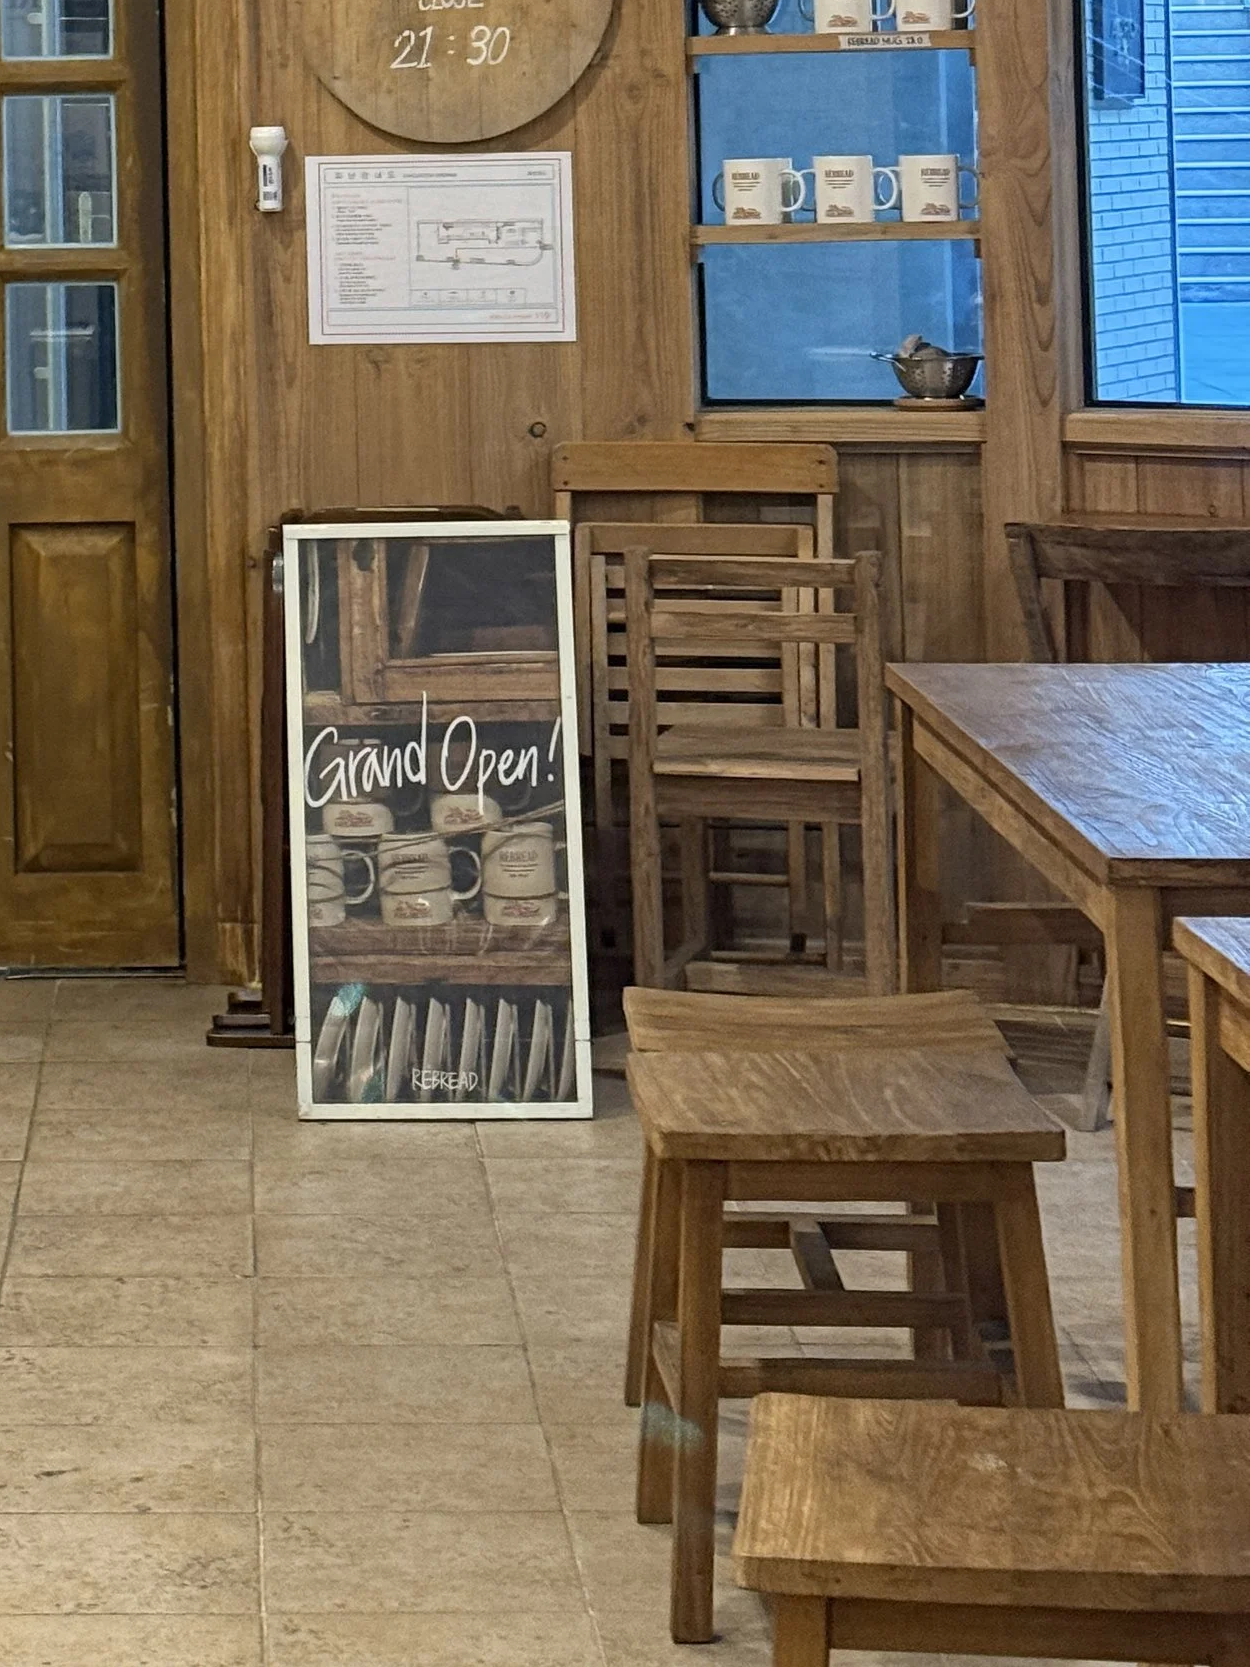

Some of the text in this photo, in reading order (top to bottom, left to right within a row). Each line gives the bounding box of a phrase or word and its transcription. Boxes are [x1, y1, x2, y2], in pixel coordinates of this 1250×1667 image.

[304, 691, 562, 816] Grand Open!
[411, 1067, 479, 1092] REBREAD
